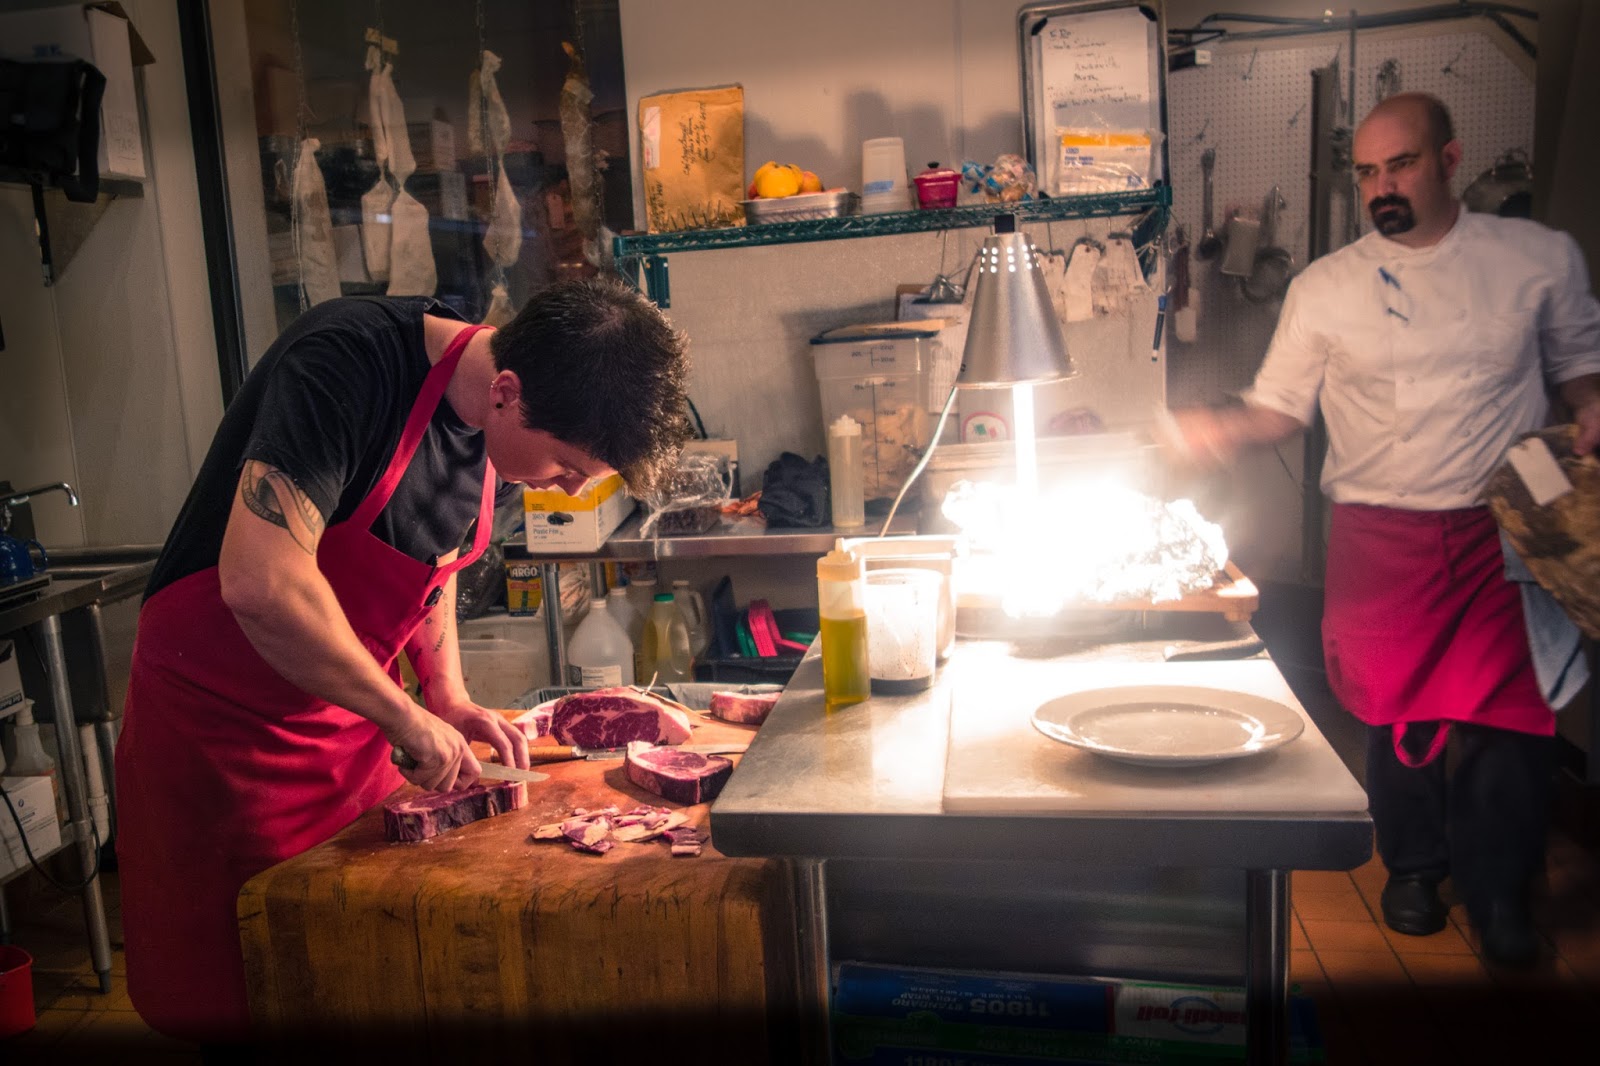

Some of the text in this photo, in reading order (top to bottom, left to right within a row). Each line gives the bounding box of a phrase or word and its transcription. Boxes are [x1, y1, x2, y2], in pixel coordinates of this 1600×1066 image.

[512, 567, 538, 578] ARGO
[434, 632, 446, 652] ASPERA
[900, 992, 931, 1000] WRAP
[891, 997, 964, 1011] STANDARD
[969, 998, 1052, 1018] 11805
